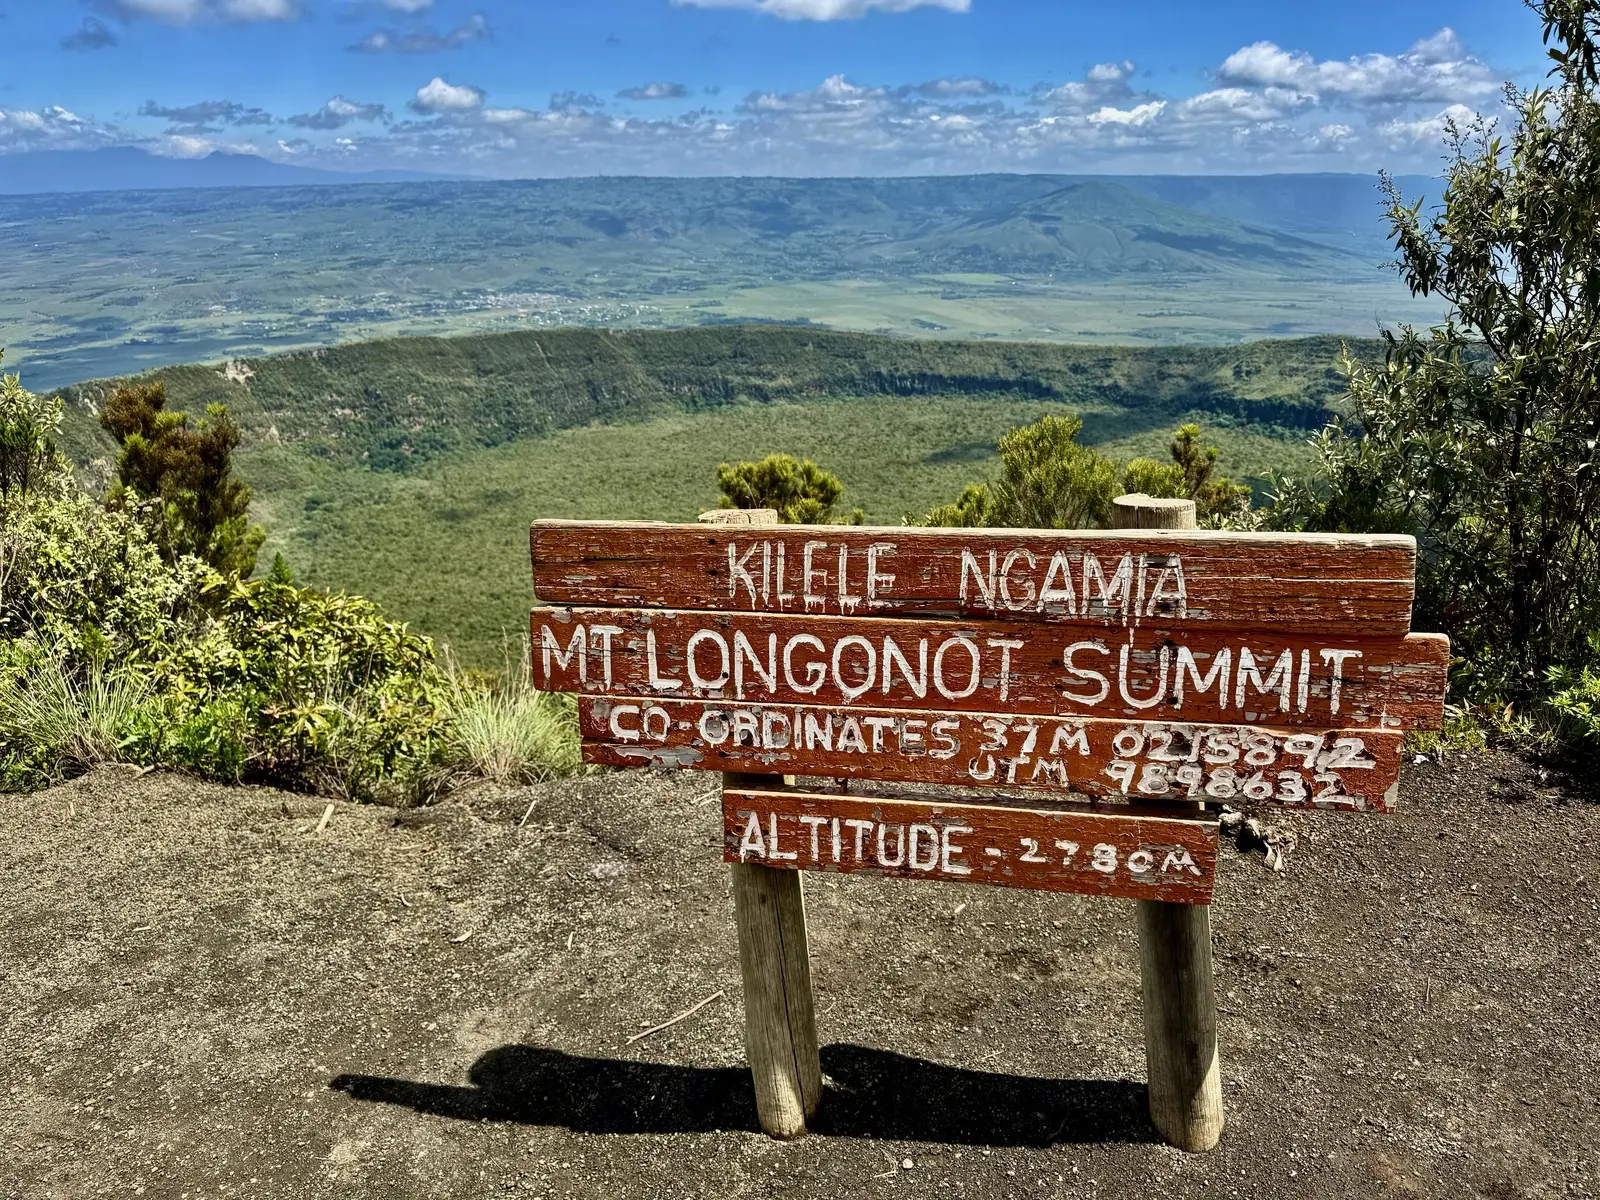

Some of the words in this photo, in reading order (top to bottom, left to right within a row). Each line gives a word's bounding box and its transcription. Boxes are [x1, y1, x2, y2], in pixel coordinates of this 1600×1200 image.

[728, 541, 897, 612] KILELE
[959, 547, 1188, 622] NGAMIA
[541, 622, 624, 694] MT
[647, 628, 1024, 702] LONGONOT
[1061, 640, 1364, 716] SUMMIT
[609, 705, 961, 759] CO-ORDINATES
[968, 754, 1069, 788] UTM
[1106, 759, 1357, 802] 9898632
[740, 811, 973, 874] ALTITUDE
